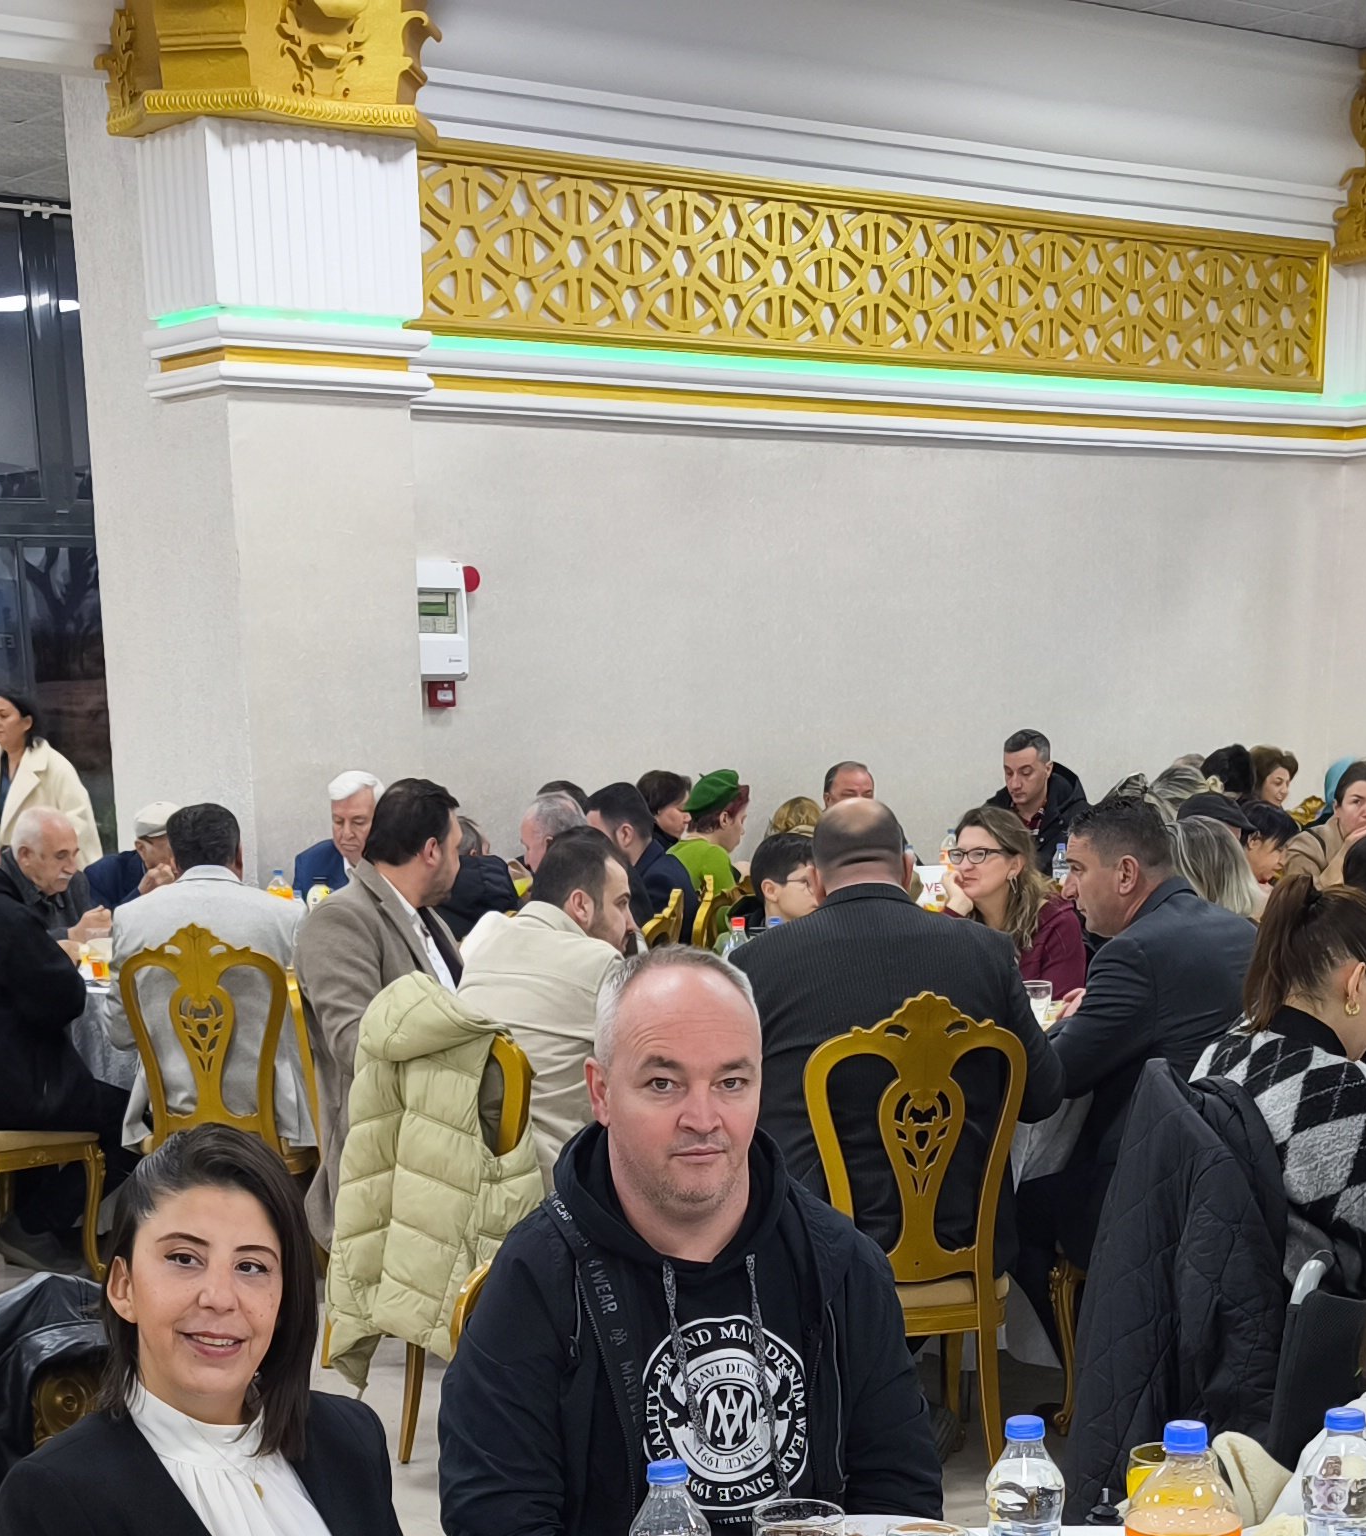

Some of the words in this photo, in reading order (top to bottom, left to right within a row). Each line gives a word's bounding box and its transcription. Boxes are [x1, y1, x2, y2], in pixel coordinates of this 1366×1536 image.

[653, 1328, 712, 1378] BRND
[646, 1384, 674, 1461] UALITY
[695, 1446, 719, 1469] 1991
[724, 1443, 764, 1470] SINCE
[716, 1472, 775, 1502] SINCE
